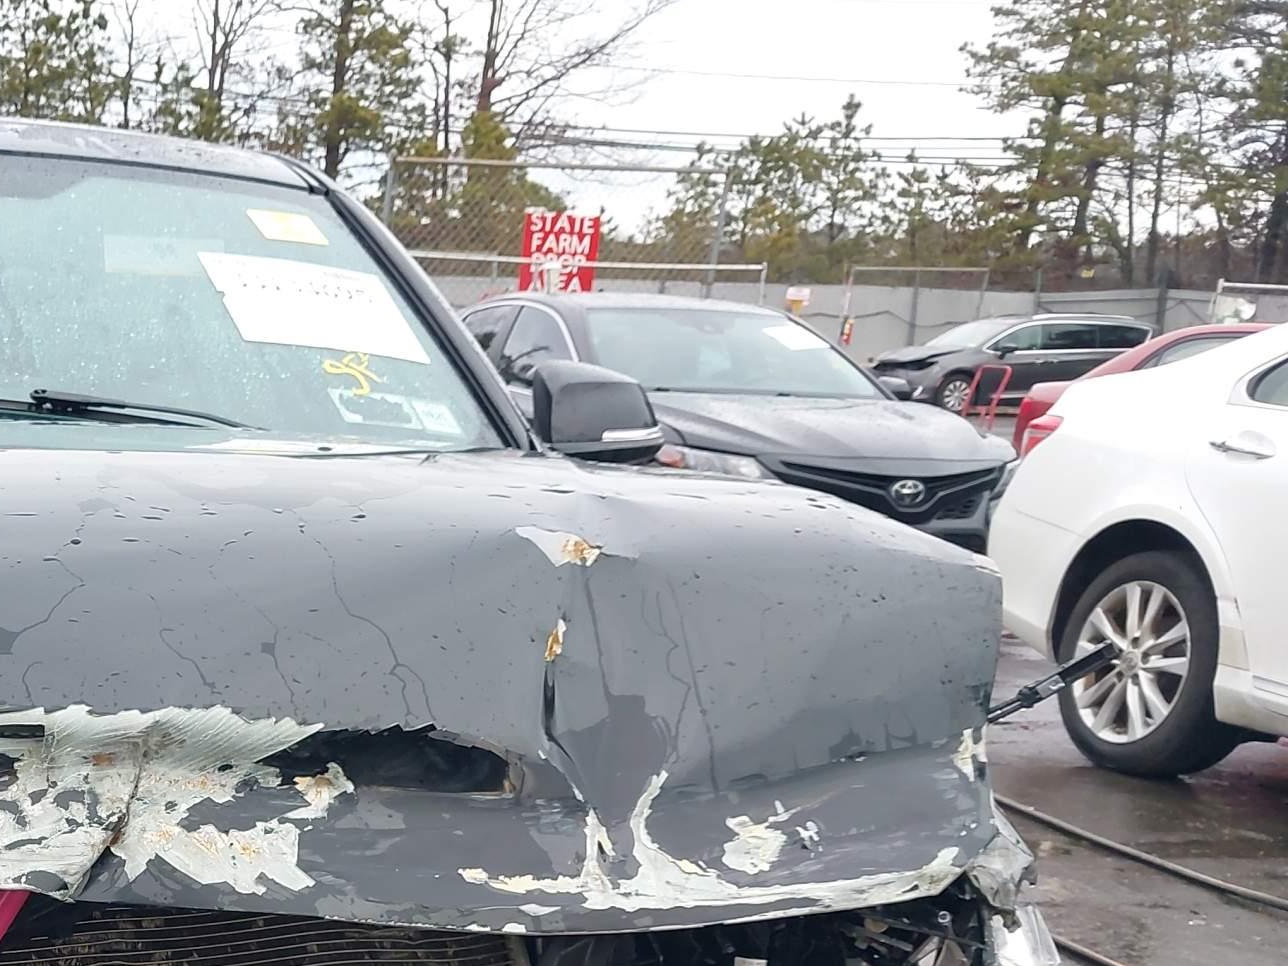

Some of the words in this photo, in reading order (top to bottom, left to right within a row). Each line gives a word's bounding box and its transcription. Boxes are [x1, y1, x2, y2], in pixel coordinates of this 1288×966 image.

[530, 211, 595, 233] STATE
[530, 232, 592, 255] FARM
[526, 270, 583, 293] AEA
